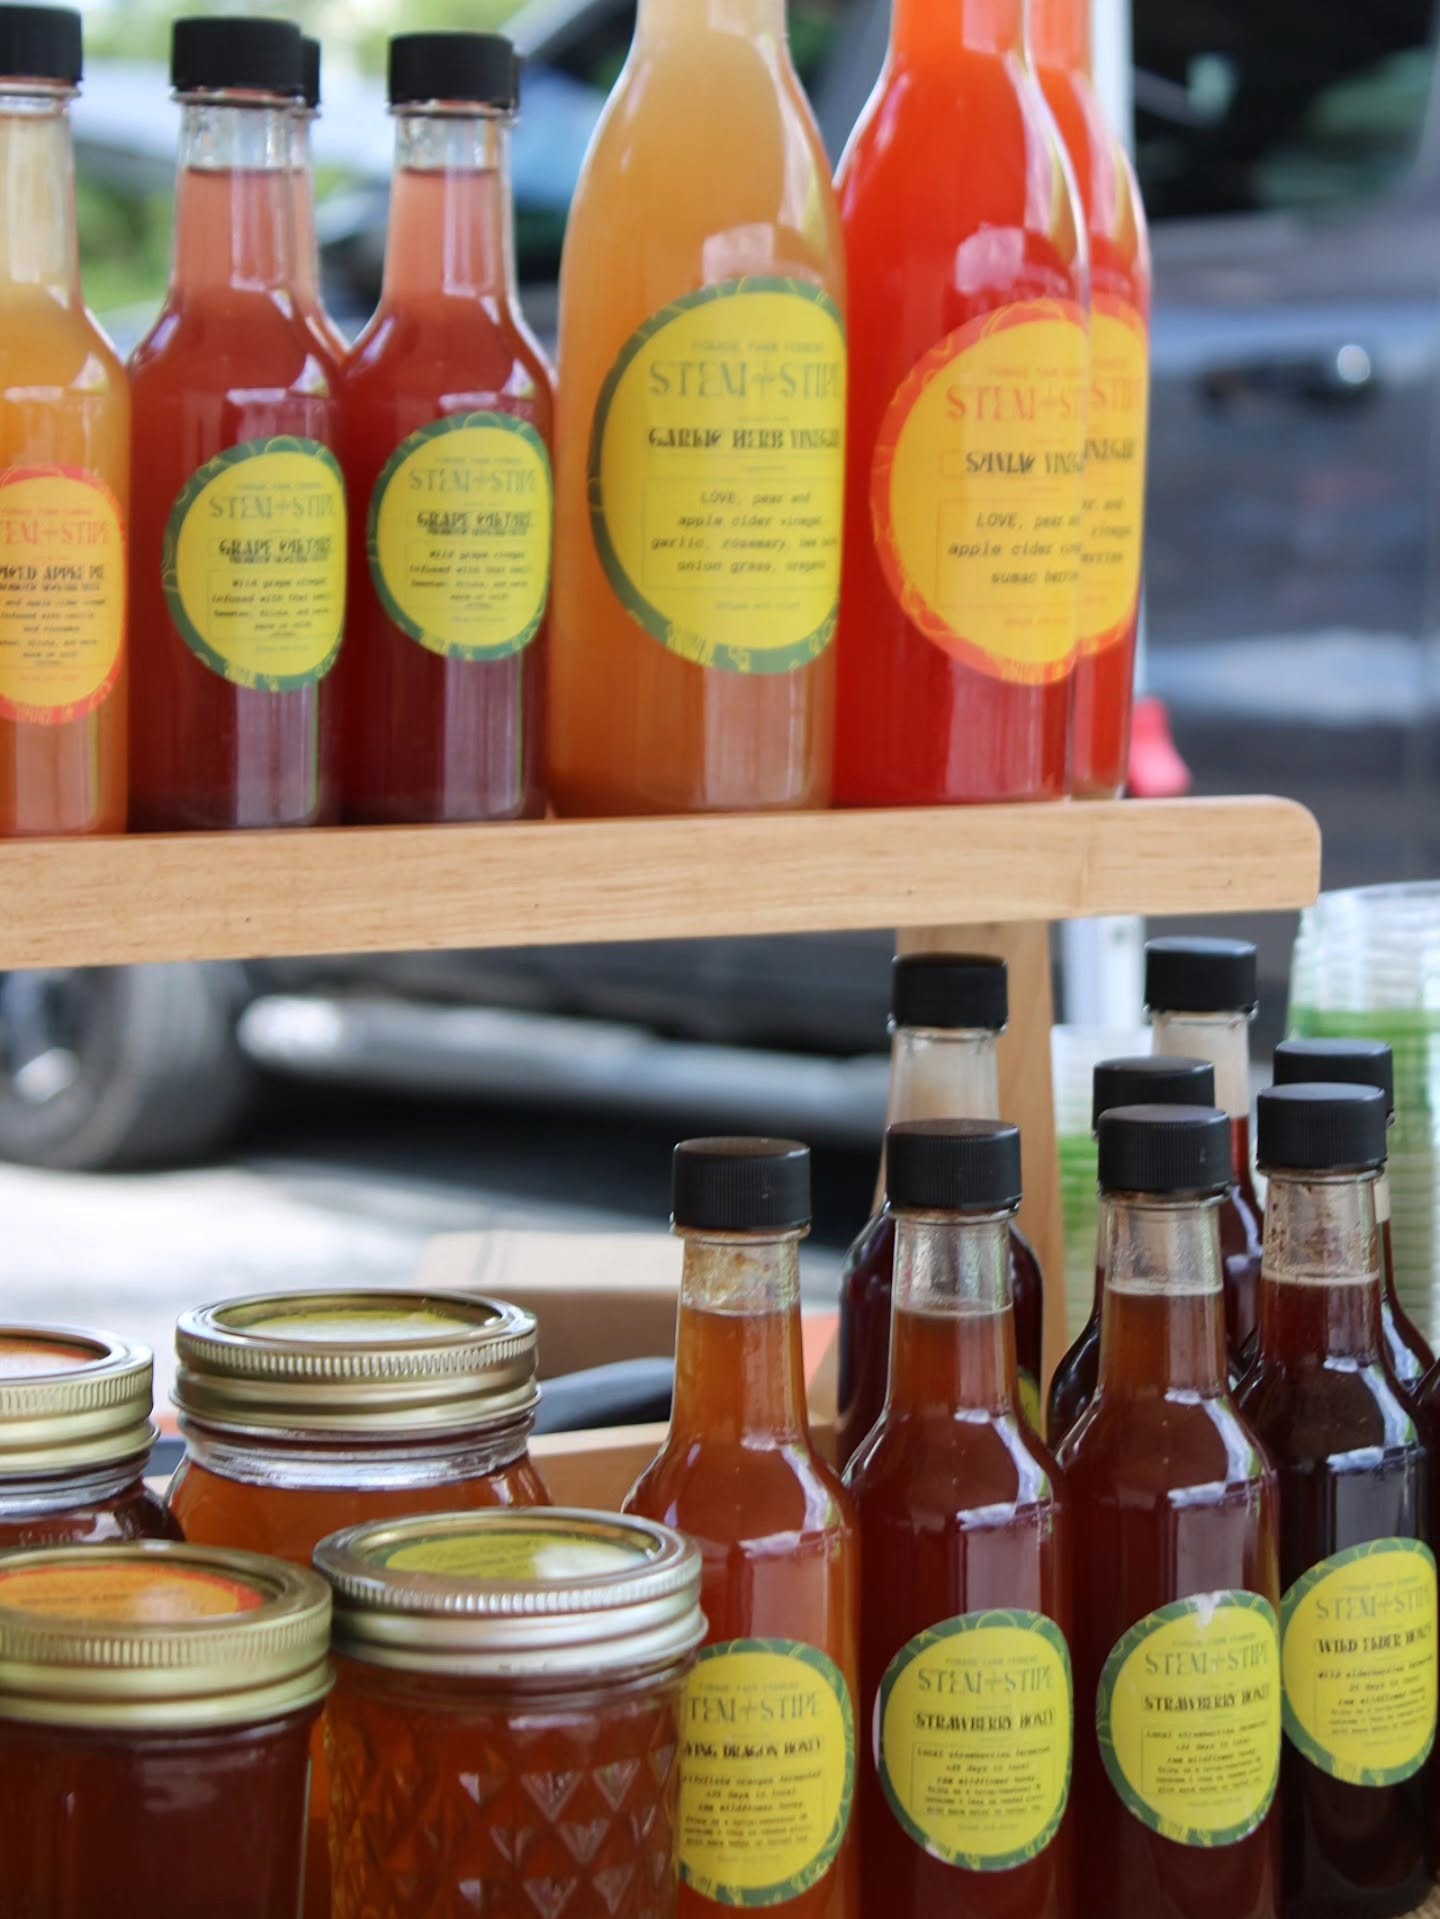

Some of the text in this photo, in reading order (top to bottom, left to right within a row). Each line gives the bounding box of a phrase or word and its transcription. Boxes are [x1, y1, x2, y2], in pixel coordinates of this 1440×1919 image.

[648, 427, 841, 448] GARLIC HERB VINEGA
[677, 513, 724, 528] apple
[975, 511, 1024, 529] LOVE,
[651, 535, 710, 551] garlic,
[947, 540, 1002, 558] apple
[1011, 541, 1054, 556] cider
[676, 558, 722, 573] onion
[1318, 1638, 1358, 1654] WILD
[690, 1690, 821, 1722] TEM+STIPE
[1143, 1693, 1236, 1712] STRAWBERRY
[915, 1706, 1055, 1732] STRAWBERRY HONEY
[784, 1736, 821, 1755] HONEY
